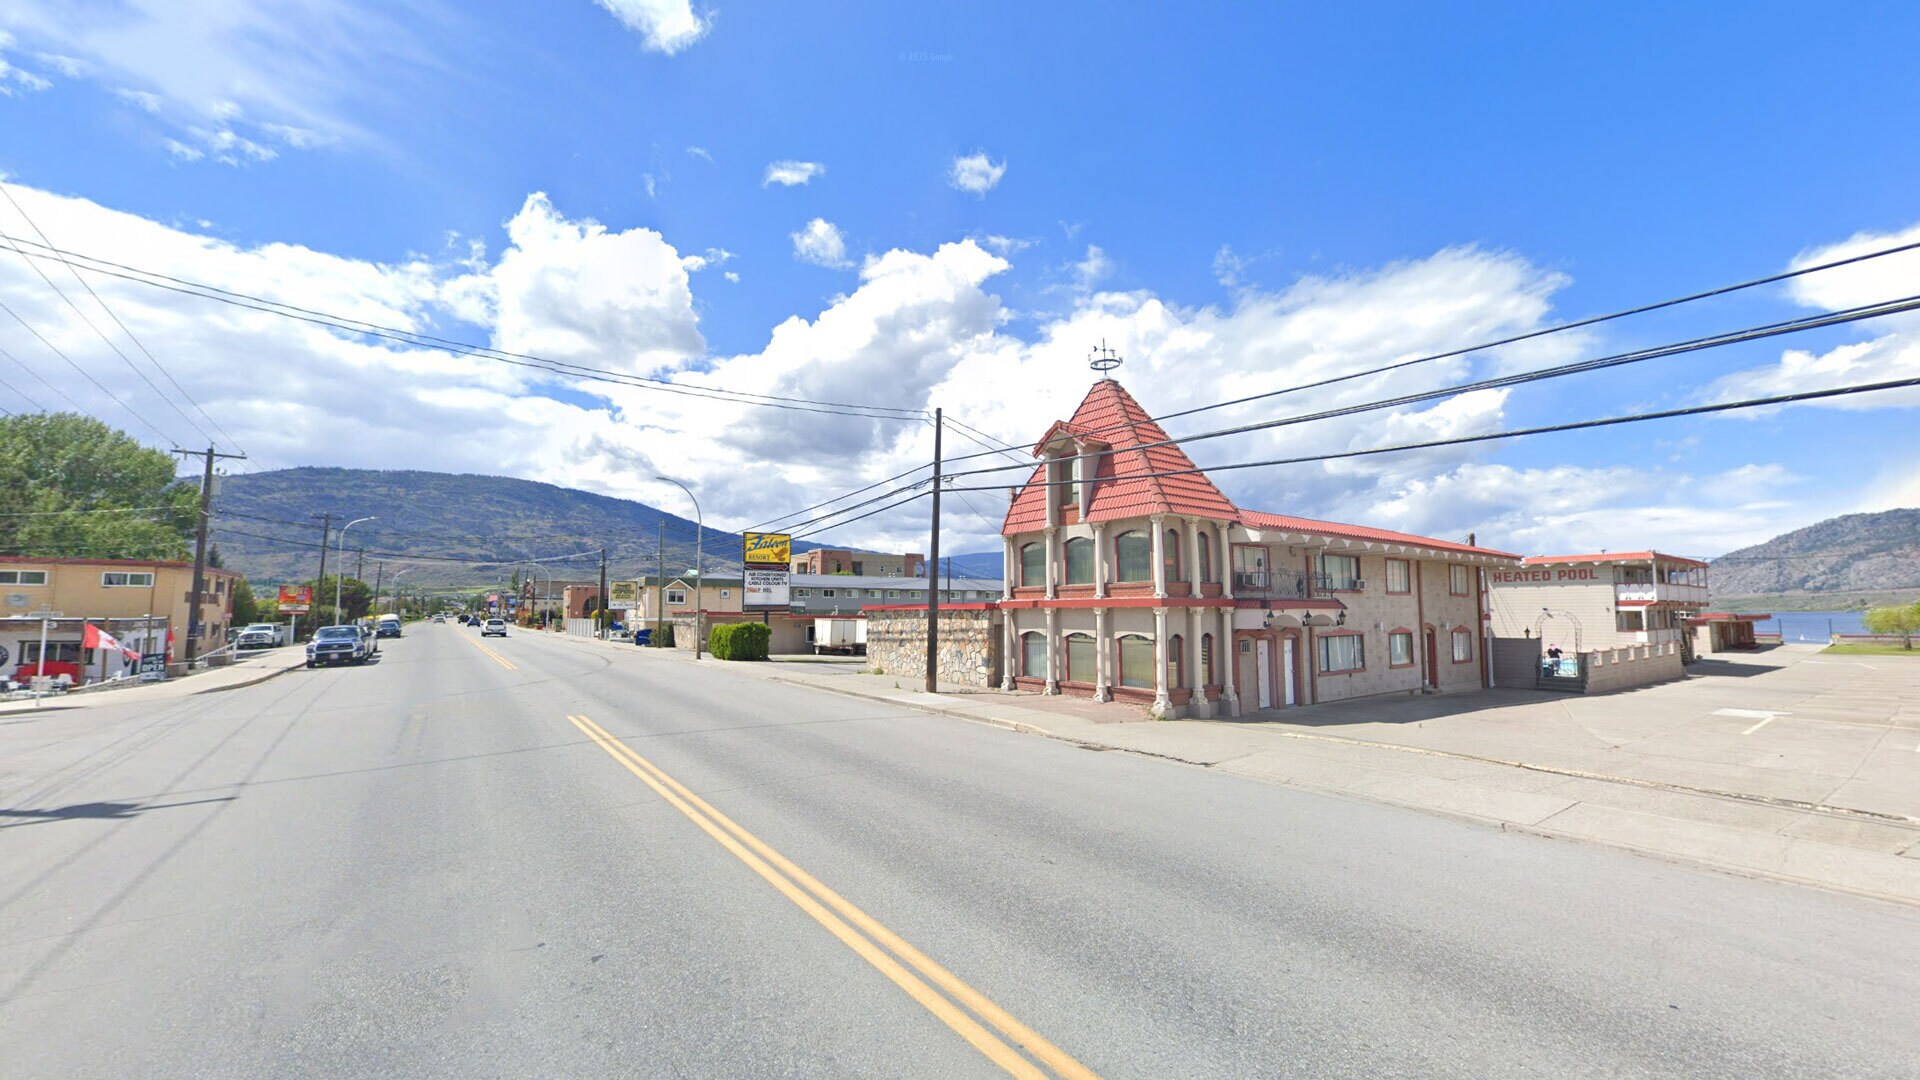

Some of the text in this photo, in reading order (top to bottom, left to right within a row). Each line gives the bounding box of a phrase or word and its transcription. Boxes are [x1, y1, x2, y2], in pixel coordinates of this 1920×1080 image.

[1493, 568, 1599, 583] HEATED POOL
[142, 664, 165, 672] OPEN
